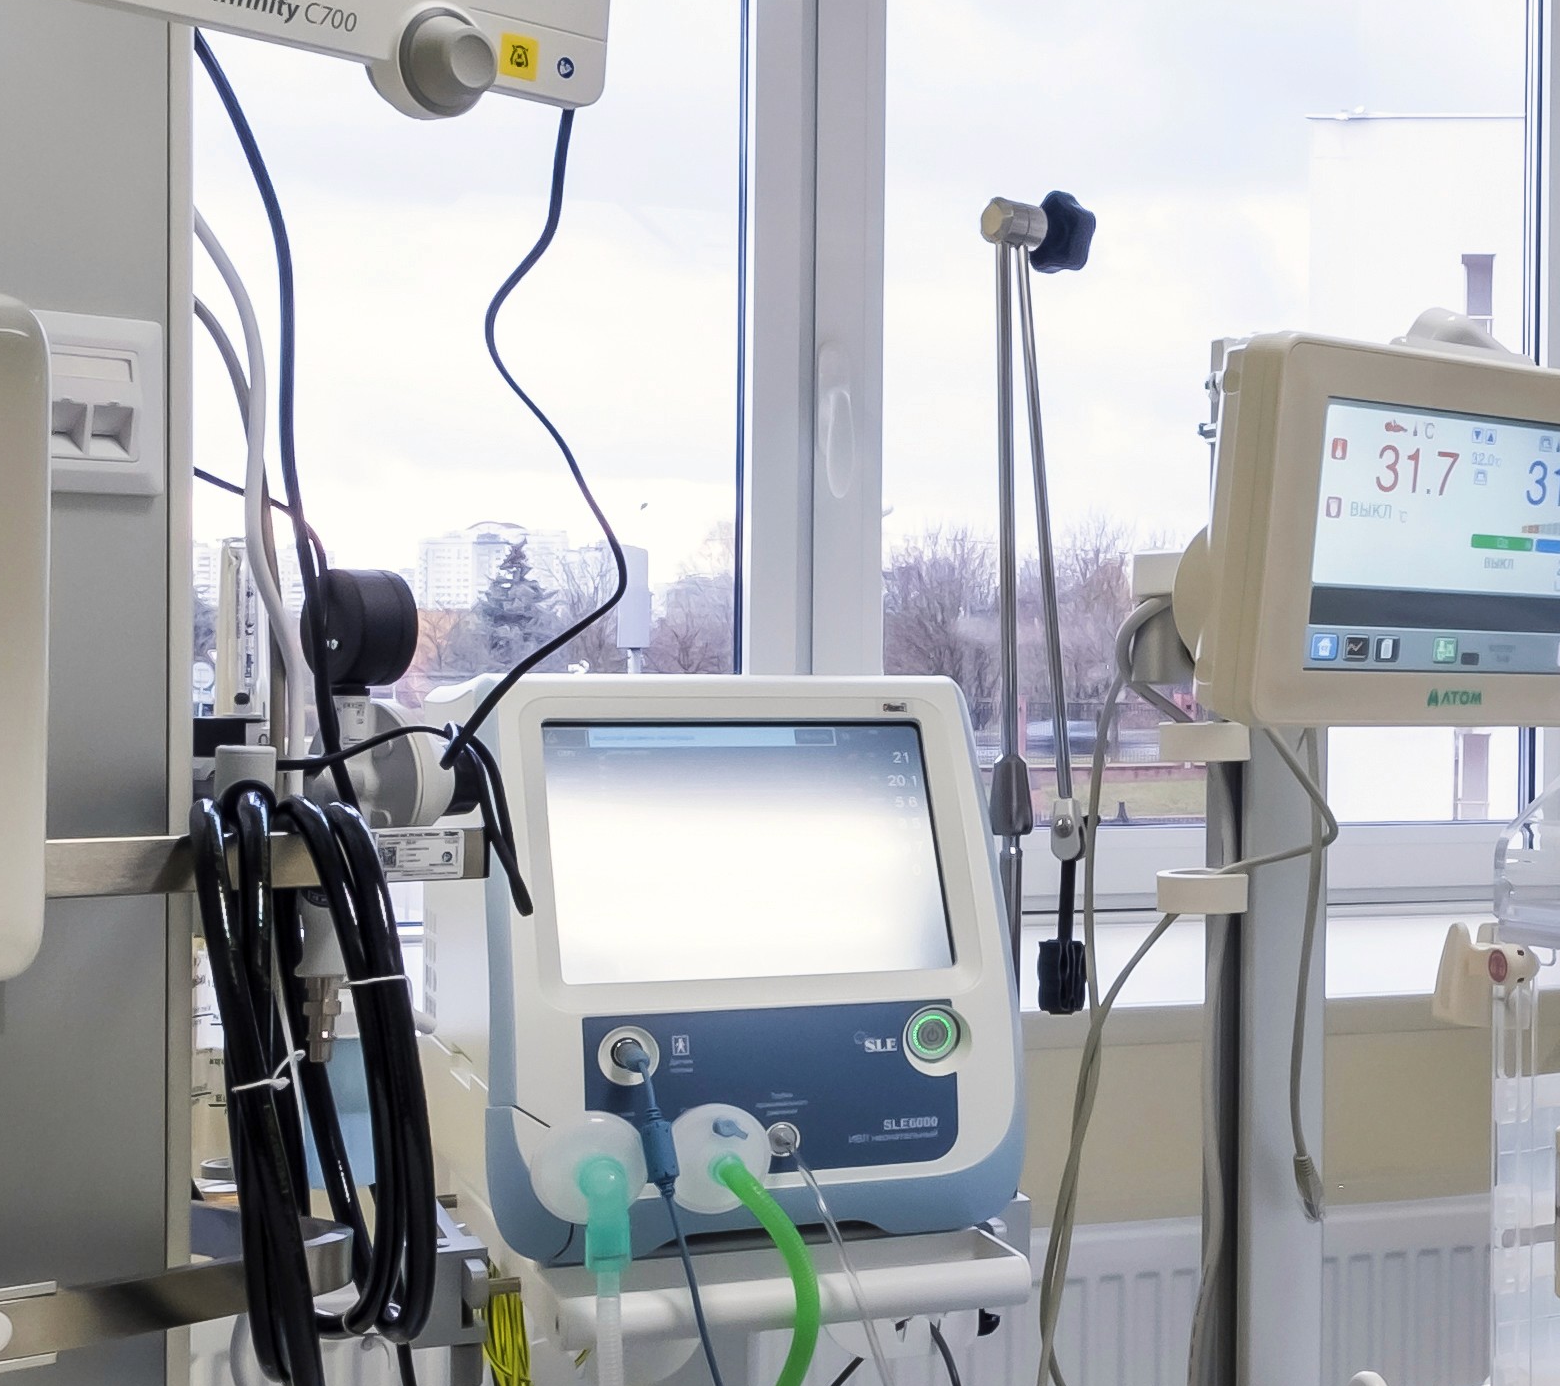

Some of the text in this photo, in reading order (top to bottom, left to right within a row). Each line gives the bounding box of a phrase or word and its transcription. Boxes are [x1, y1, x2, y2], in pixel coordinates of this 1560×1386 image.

[304, 1, 359, 34] C700
[1375, 444, 1460, 497] 31.7
[1349, 501, 1394, 520] ВЫКЛ
[1483, 555, 1515, 571] ВЫКЛ
[1440, 689, 1482, 706] ATOM
[892, 750, 910, 765] 21
[863, 1037, 898, 1053] SLE
[883, 1116, 939, 1131] SLE6000
